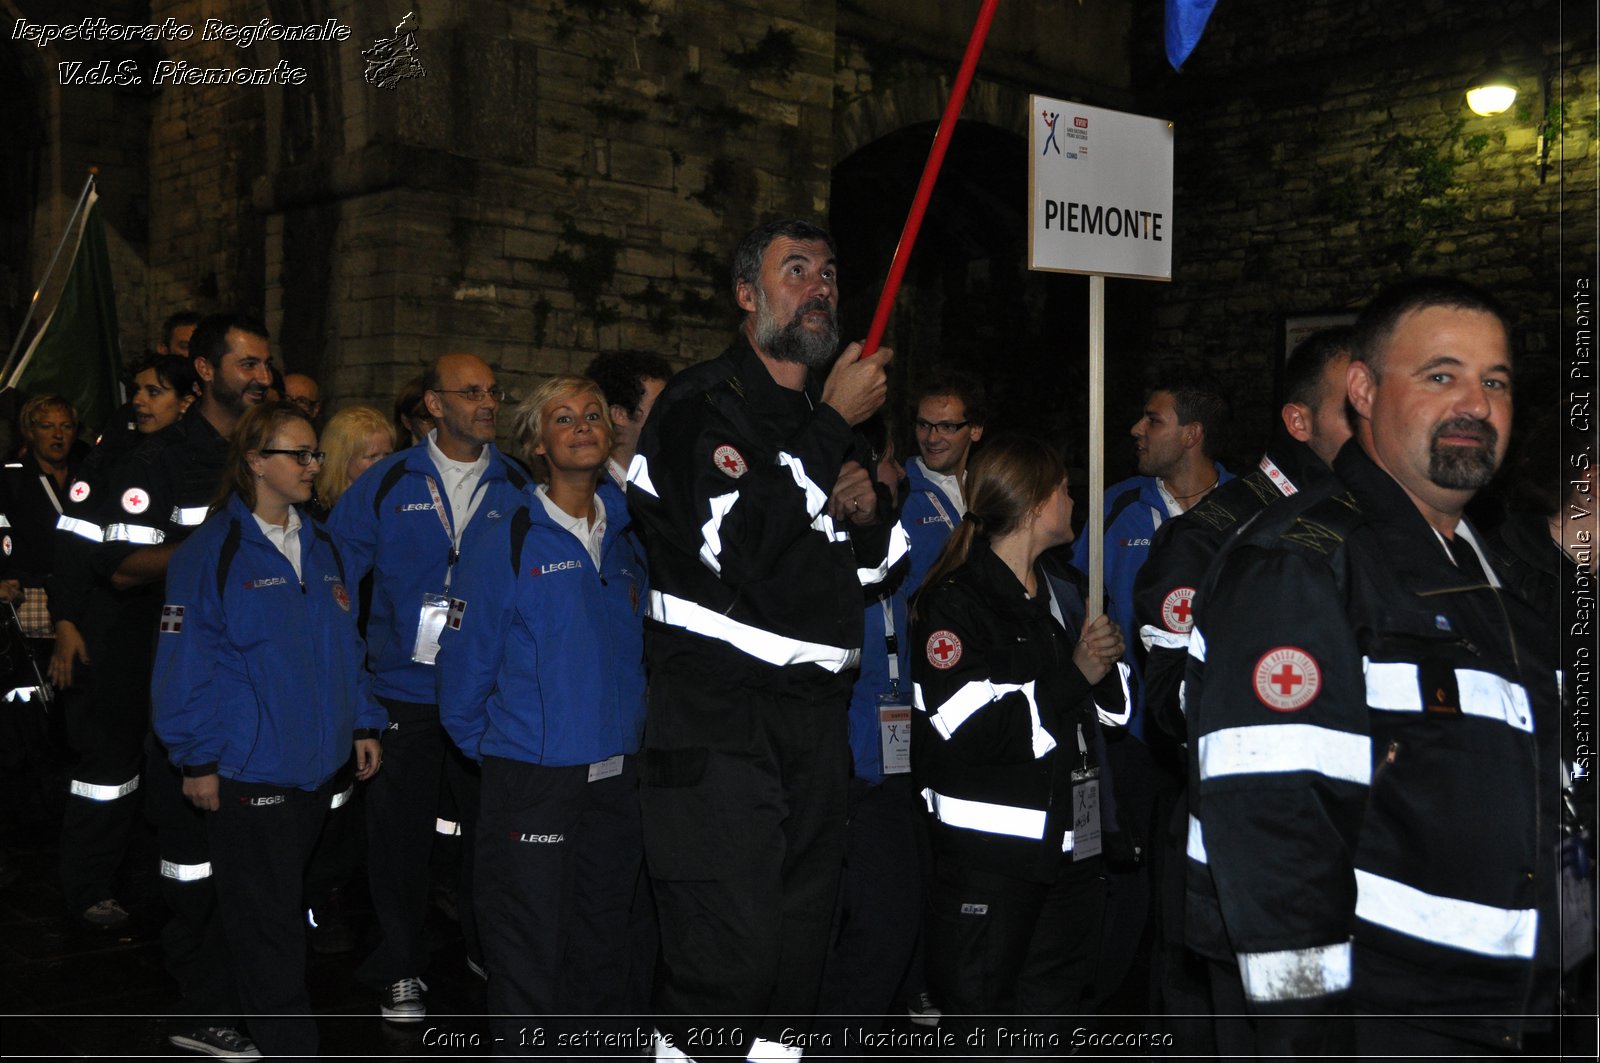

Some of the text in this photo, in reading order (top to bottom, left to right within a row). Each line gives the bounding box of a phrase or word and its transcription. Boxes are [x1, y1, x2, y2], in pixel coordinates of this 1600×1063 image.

[1045, 199, 1163, 241] PIEMONTE
[1127, 538, 1151, 546] LEG
[541, 560, 583, 575] LEGEA
[254, 577, 287, 588] LEGEA
[520, 833, 565, 843] LEGEA
